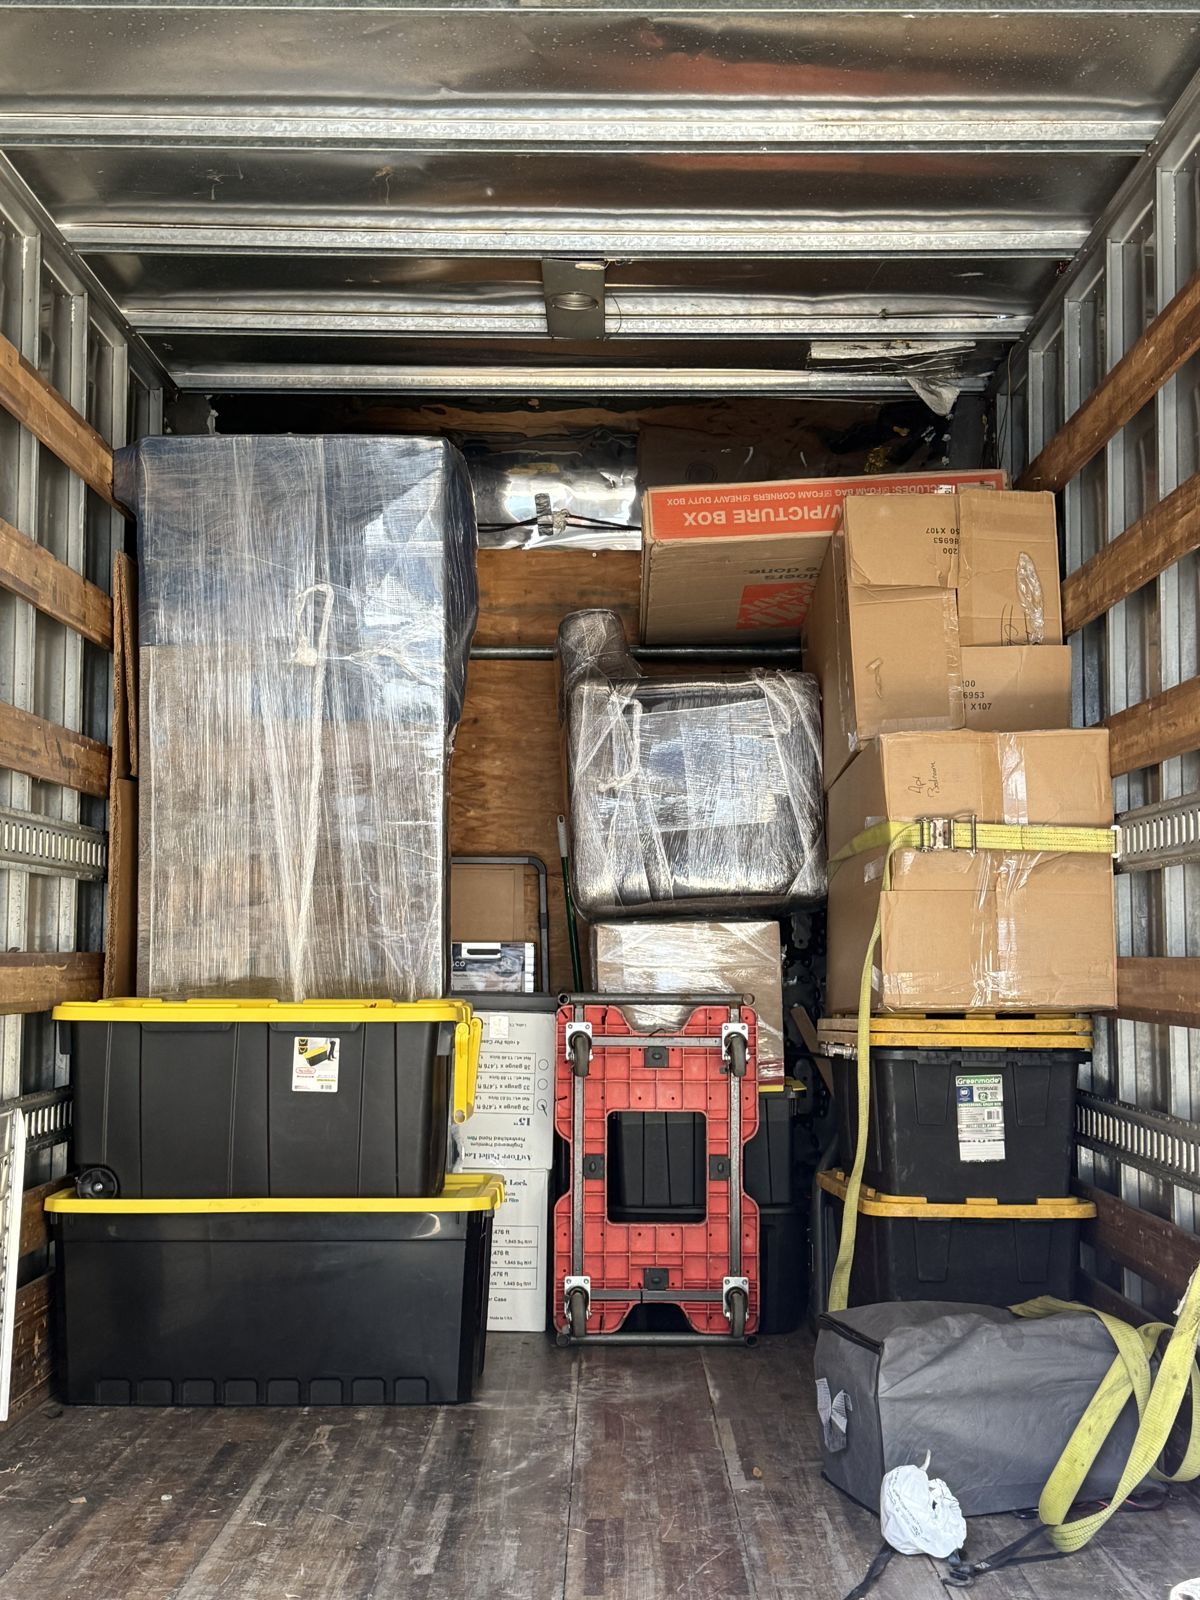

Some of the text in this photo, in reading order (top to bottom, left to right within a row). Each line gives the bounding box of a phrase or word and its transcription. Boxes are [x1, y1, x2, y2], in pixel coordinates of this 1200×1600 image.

[799, 490, 824, 498] FOAM
[856, 487, 881, 495] FOAM
[690, 496, 712, 505] DUTY
[714, 495, 742, 504] HEAVY
[754, 492, 796, 501] CORNERS
[684, 512, 727, 526] BOX
